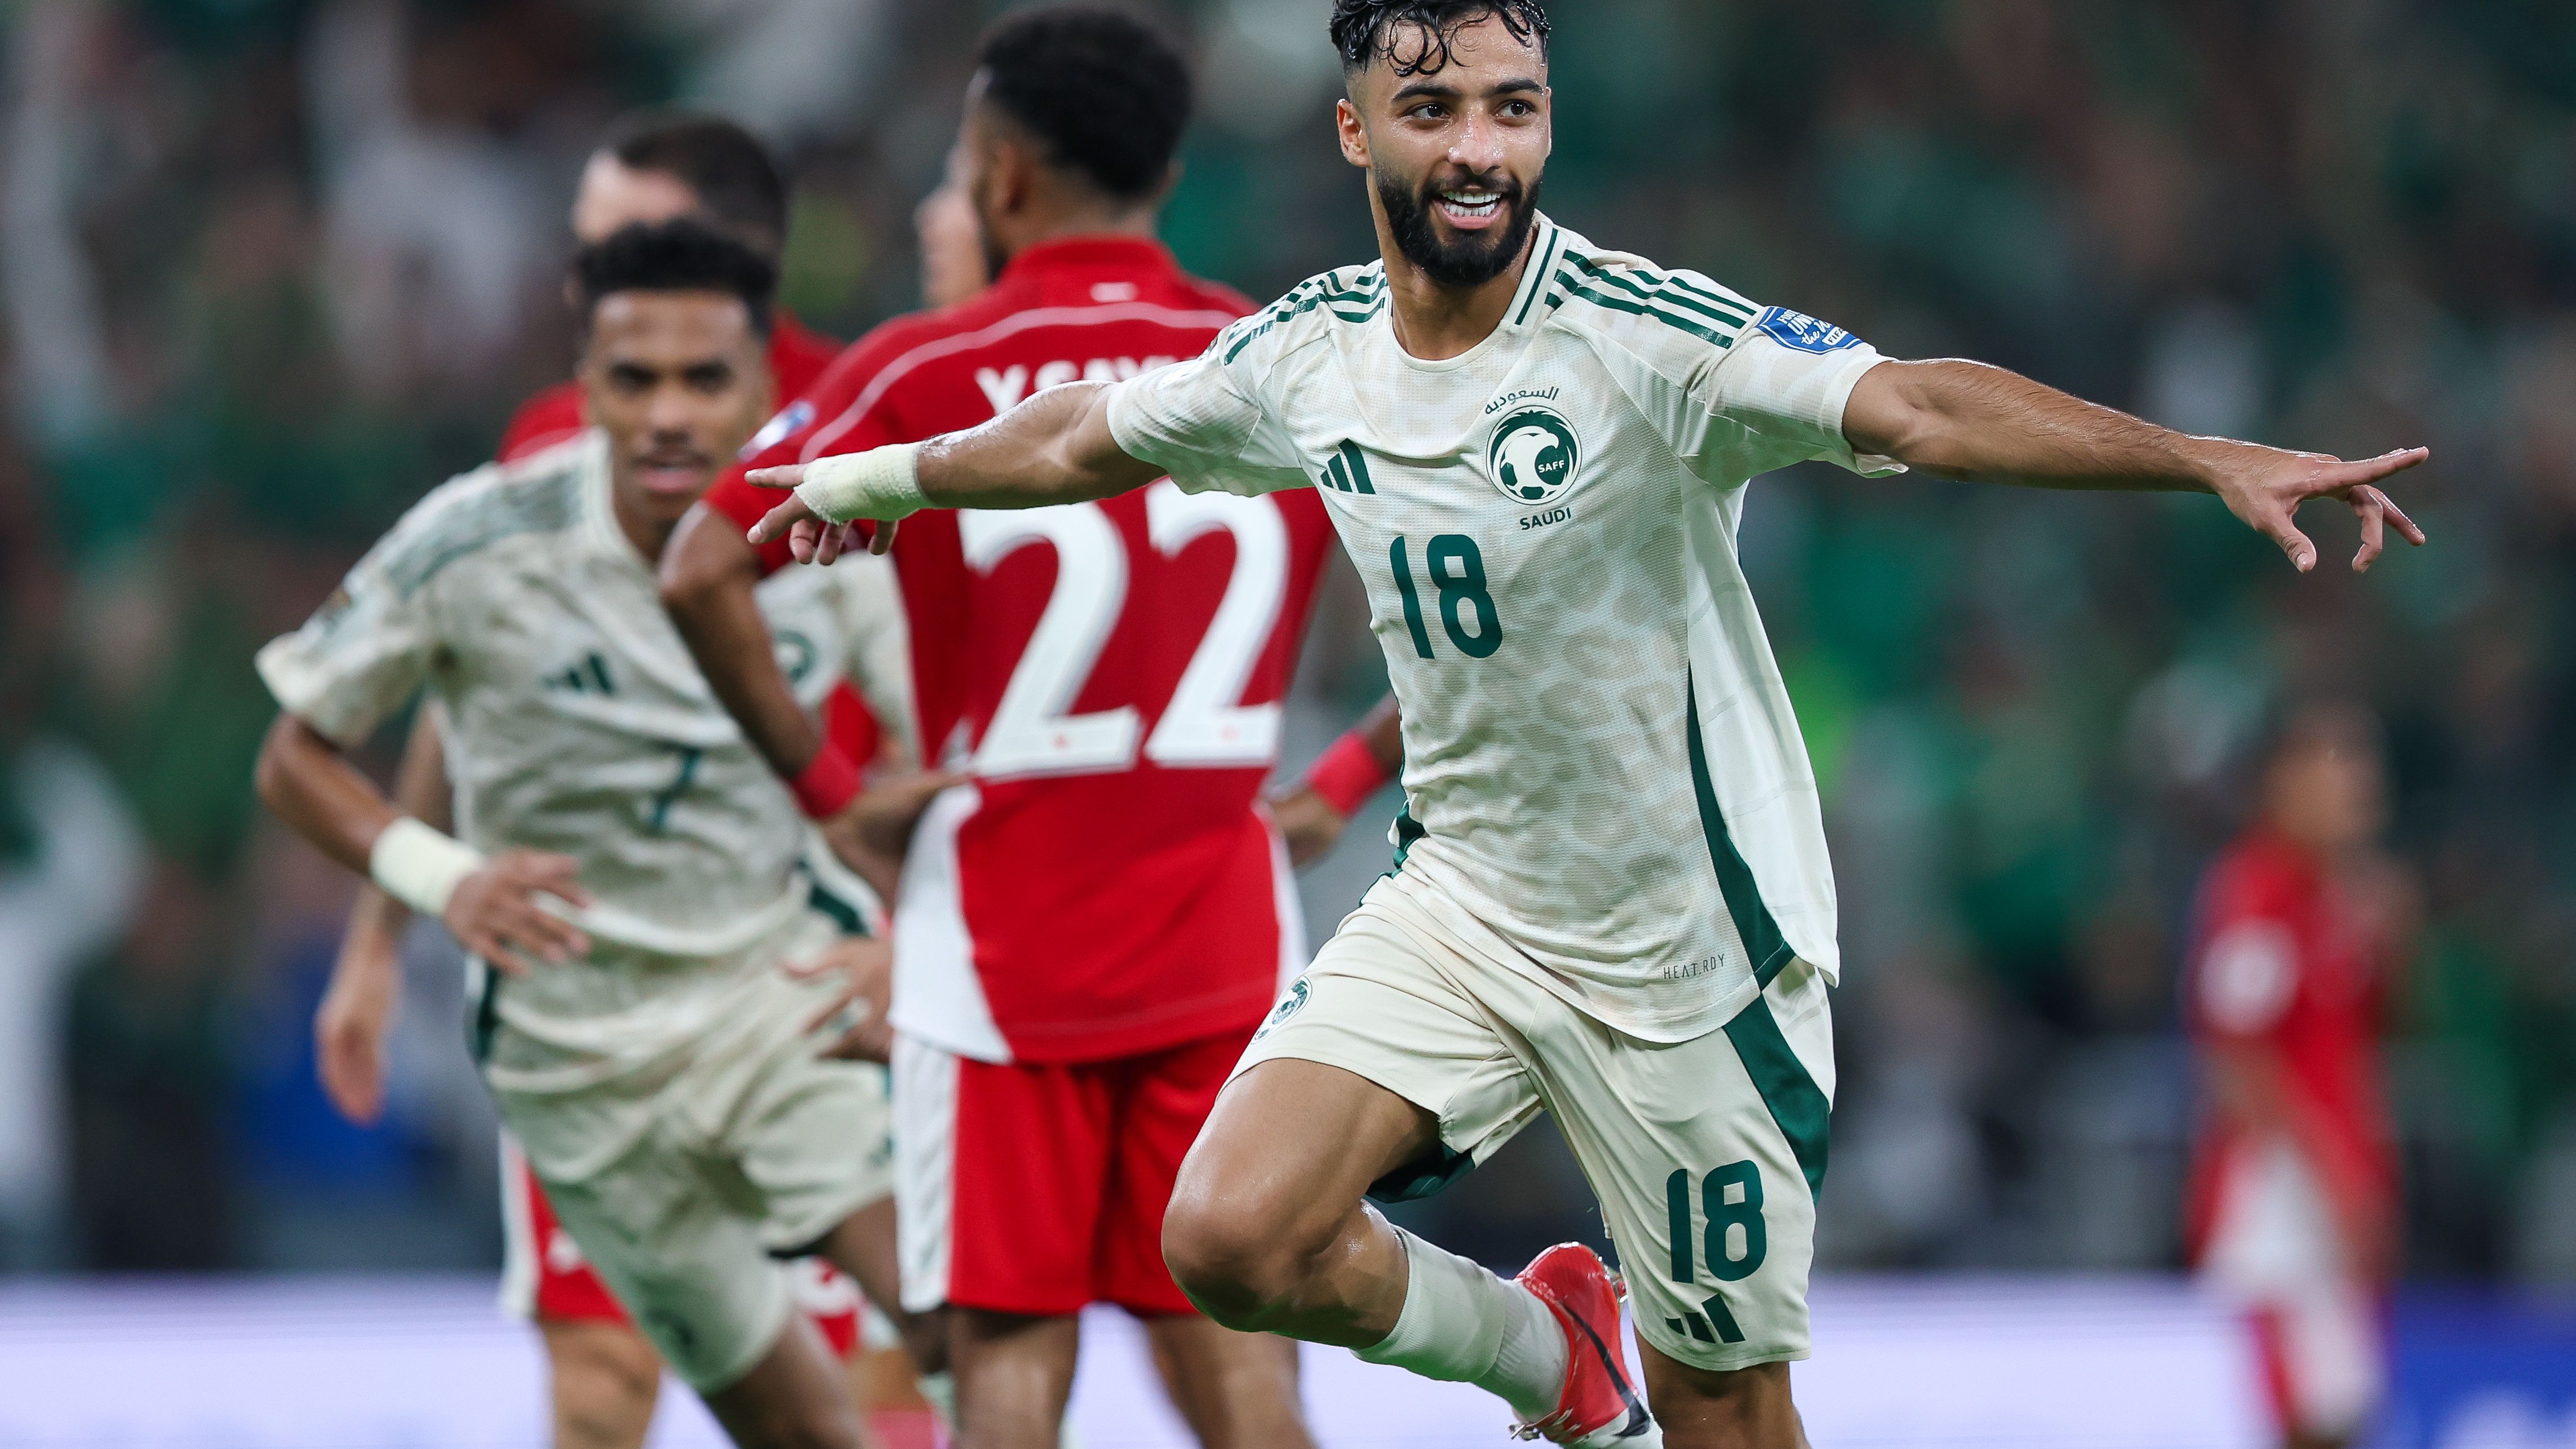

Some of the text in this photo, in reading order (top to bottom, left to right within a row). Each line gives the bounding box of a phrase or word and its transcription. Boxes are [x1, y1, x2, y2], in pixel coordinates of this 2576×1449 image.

[1787, 313, 1815, 335] UNI
[1801, 330, 1820, 345] the
[1538, 459, 1564, 473] SAFF
[1519, 507, 1572, 530] SAUDI
[1389, 534, 1503, 659] 18
[958, 475, 1291, 781] 22
[1664, 954, 1724, 980] HEAT.RDY
[1666, 1159, 1767, 1284] 18
